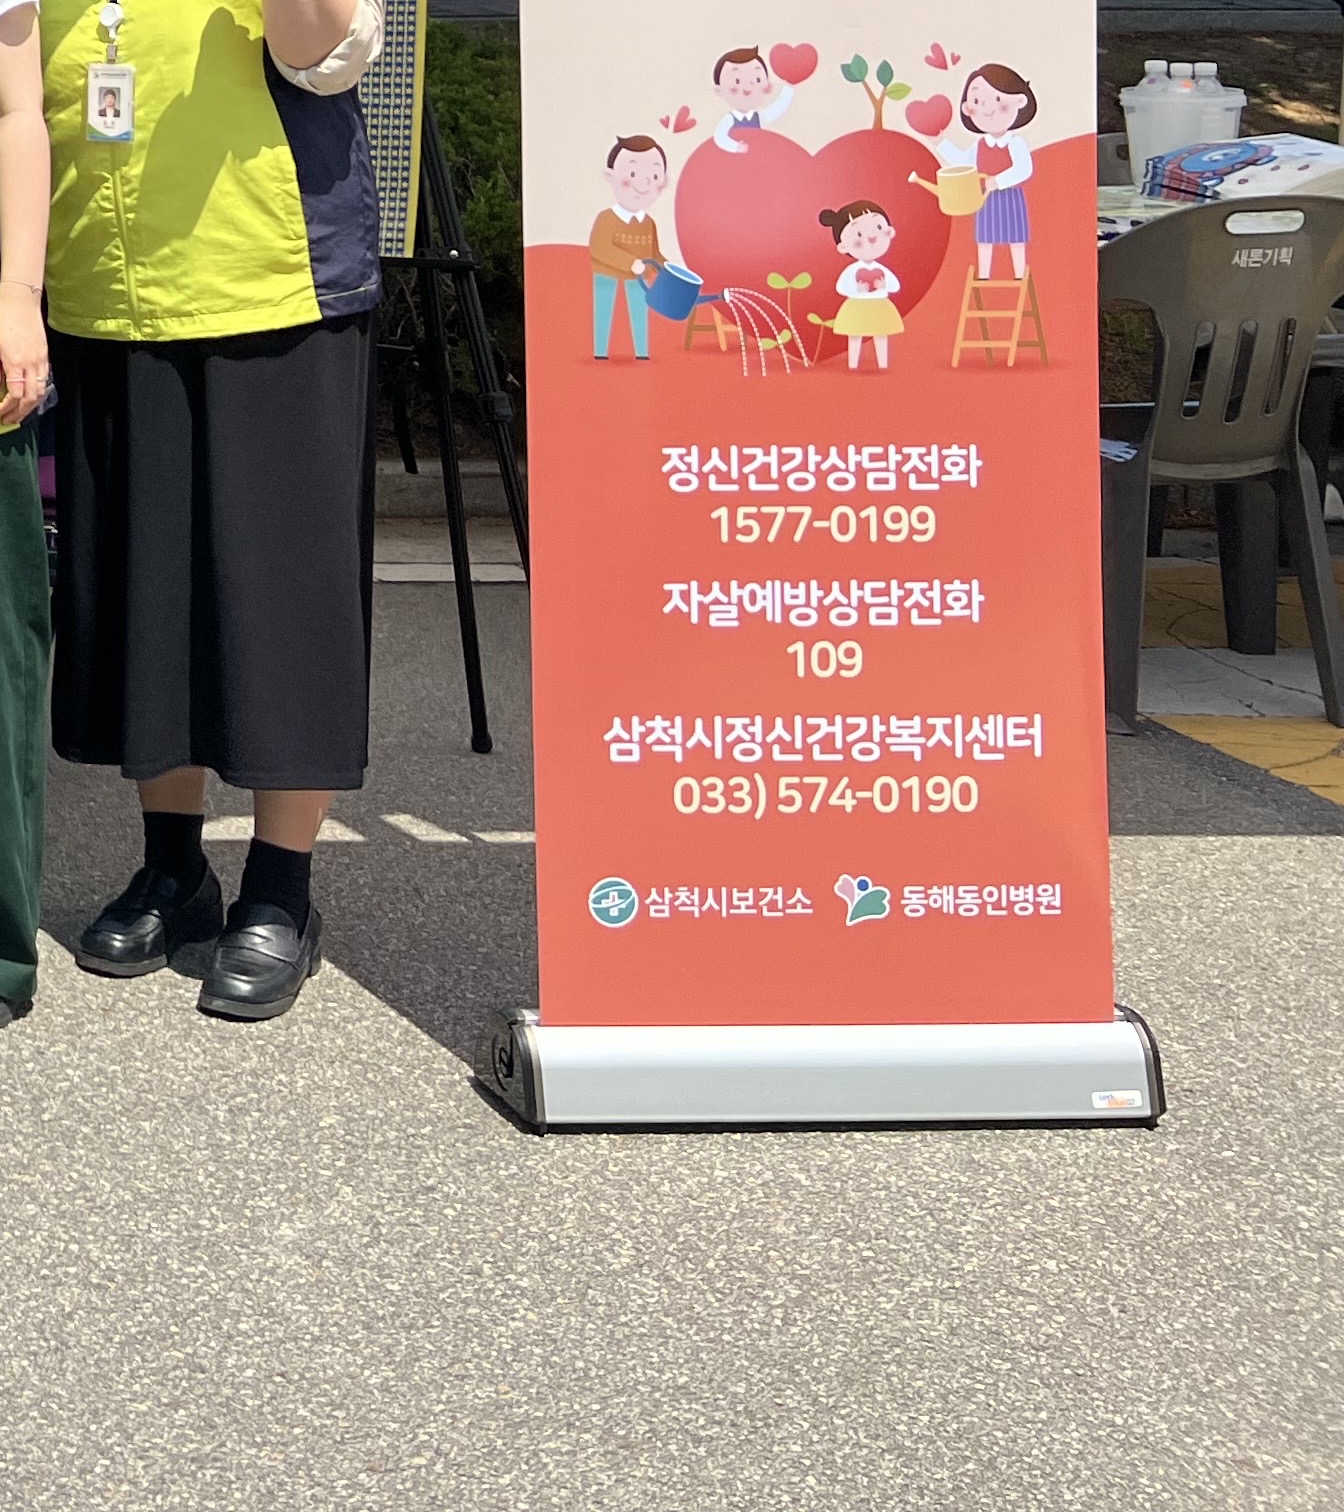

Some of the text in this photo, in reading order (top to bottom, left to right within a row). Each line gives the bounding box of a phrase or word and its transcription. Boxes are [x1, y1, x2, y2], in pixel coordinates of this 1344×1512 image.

[661, 444, 982, 491] 정신건강상담전화
[710, 505, 937, 545] 1577-0199
[662, 579, 984, 627] 자살예방상담전화
[786, 640, 864, 679] 109
[603, 713, 1043, 763] 삼척시정신건강복지센터
[673, 775, 980, 821] 033) 574-0190
[644, 883, 1062, 919] 삼척시보건소 동해동인병원
